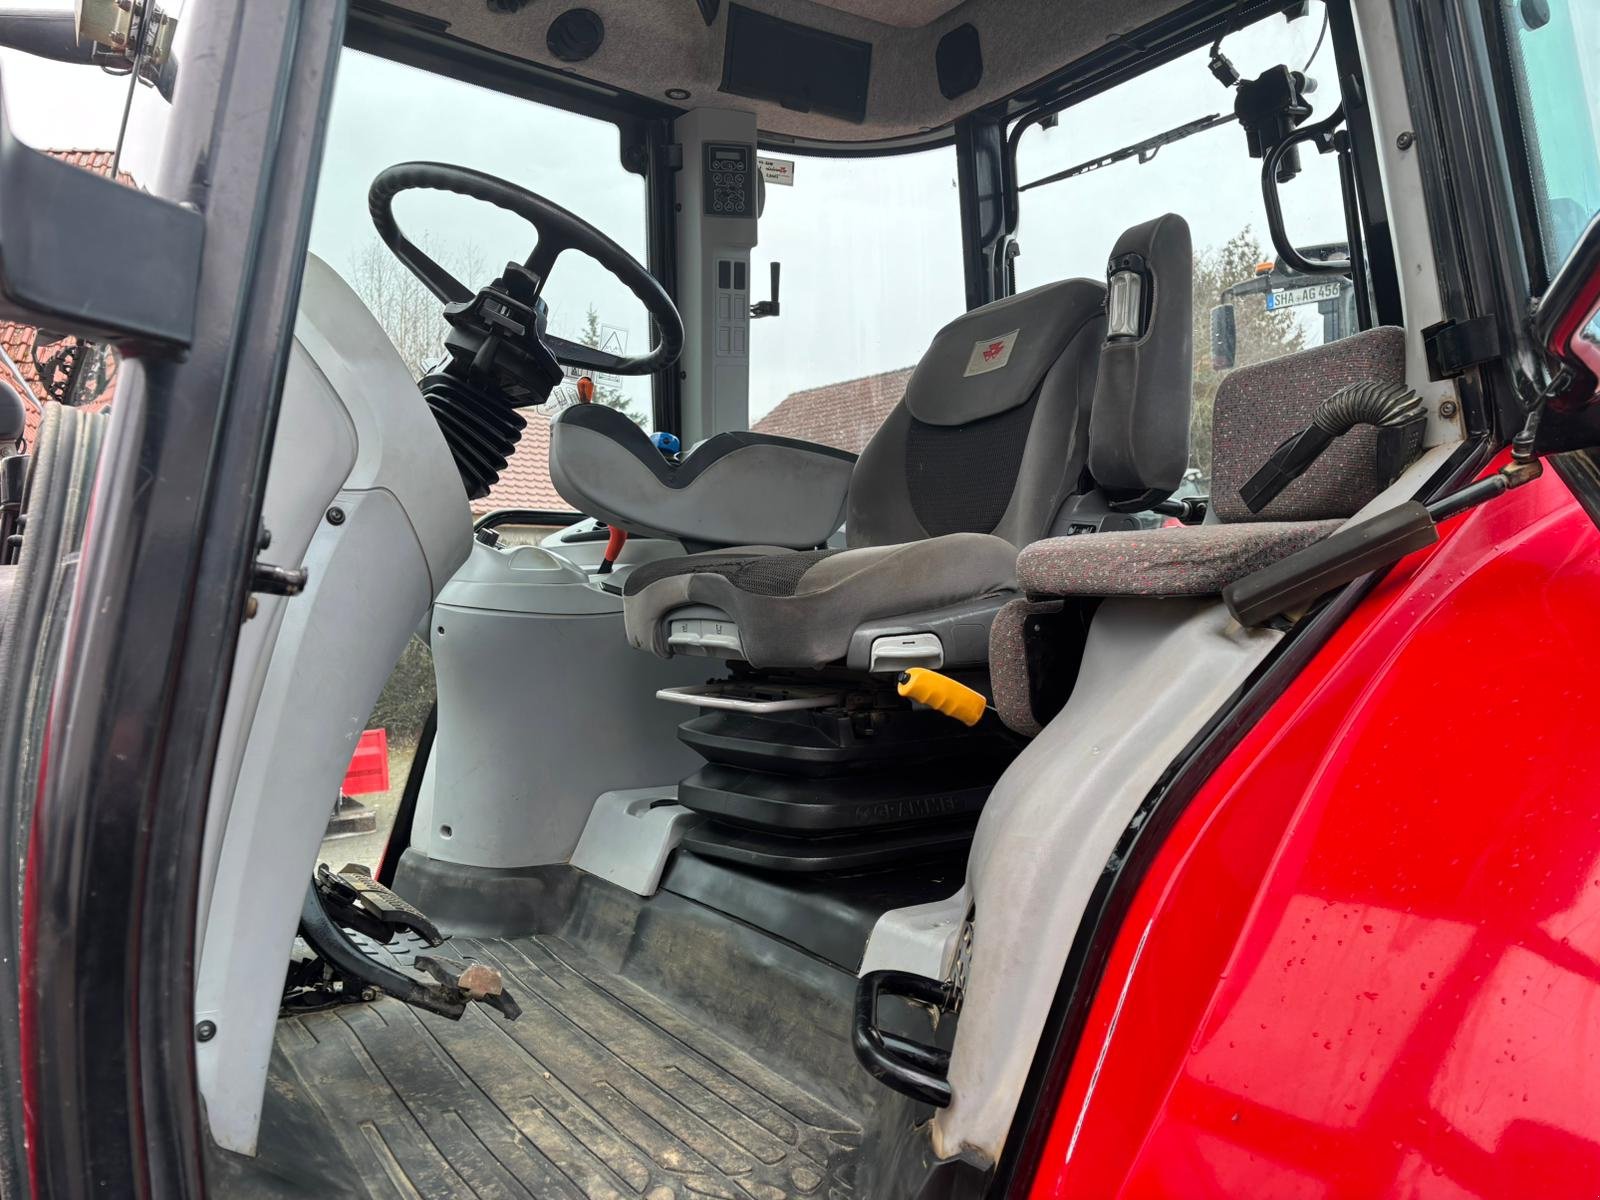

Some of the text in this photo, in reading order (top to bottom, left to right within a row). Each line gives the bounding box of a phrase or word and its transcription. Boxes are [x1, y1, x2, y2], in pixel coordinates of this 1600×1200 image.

[1274, 283, 1339, 306] SHA AG 456
